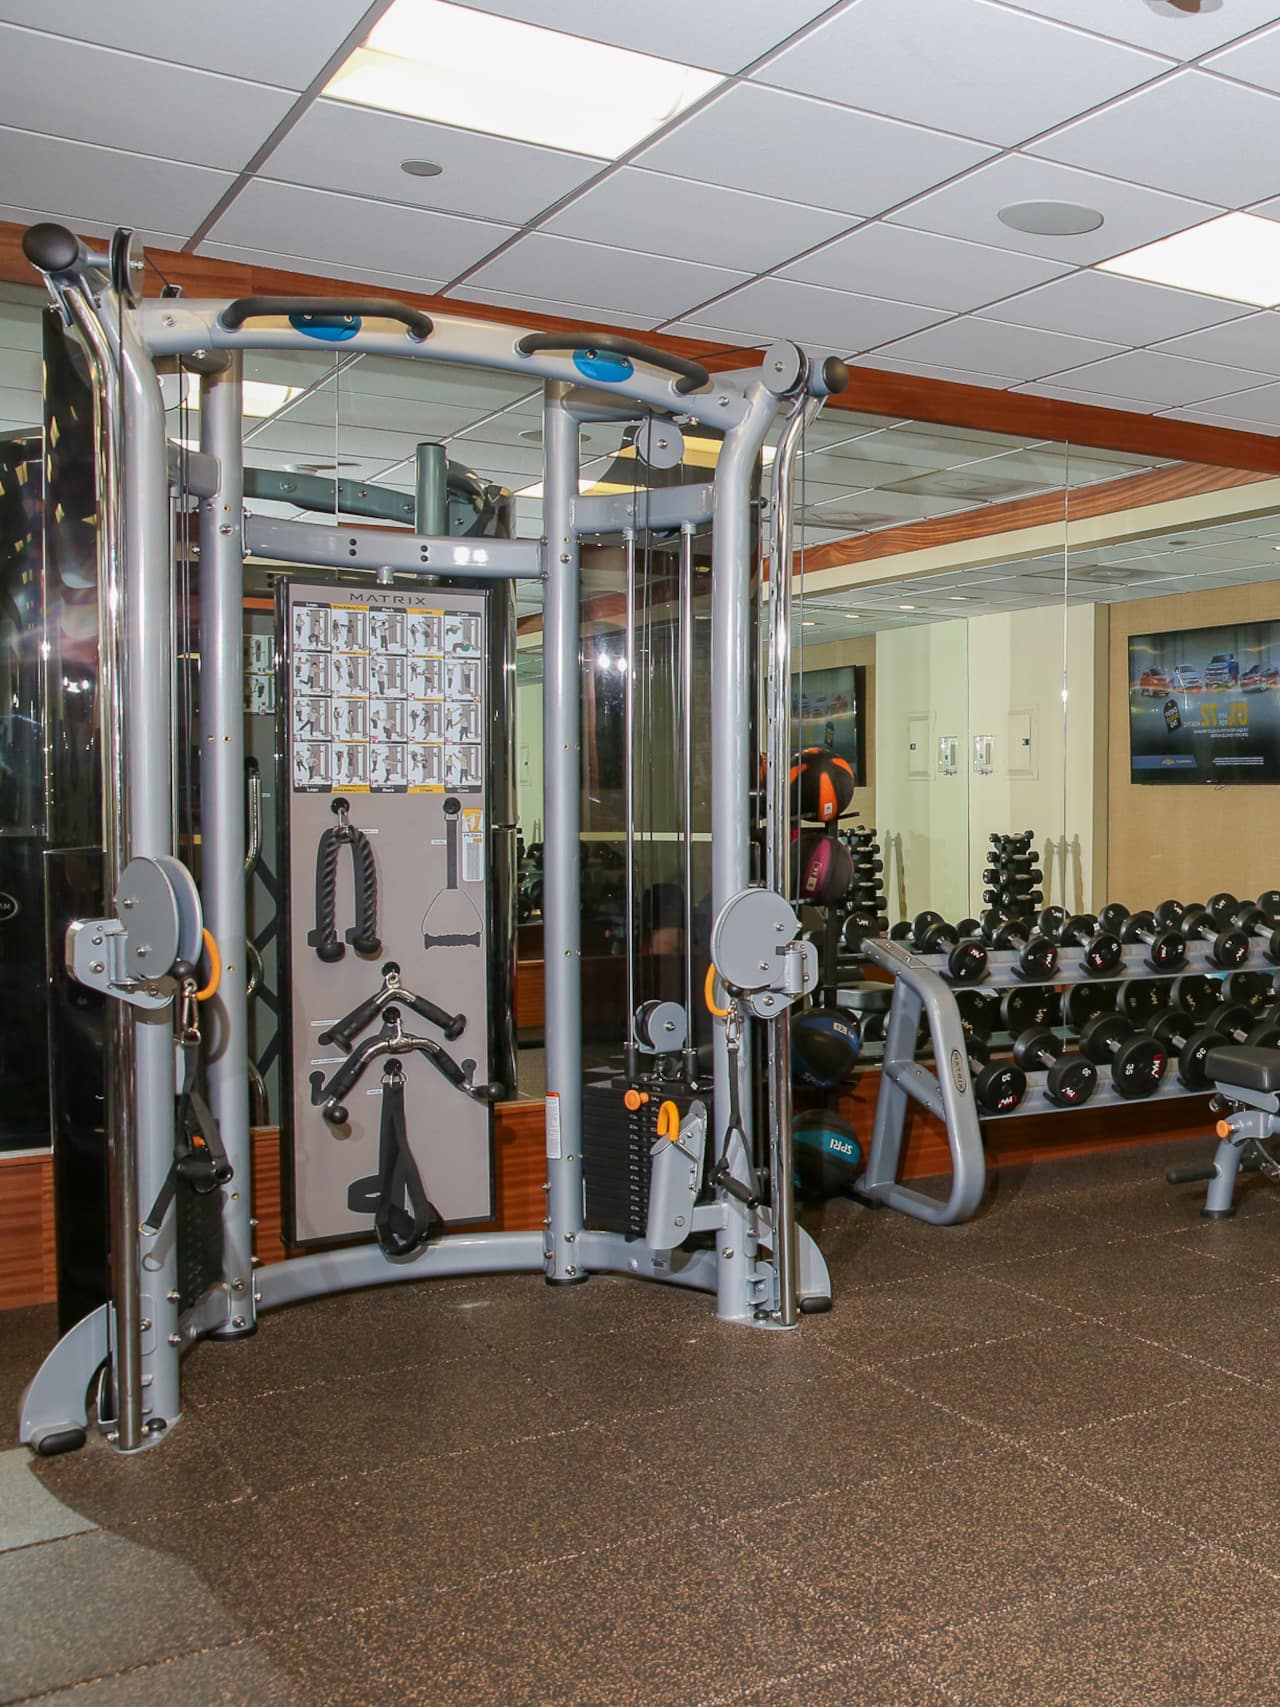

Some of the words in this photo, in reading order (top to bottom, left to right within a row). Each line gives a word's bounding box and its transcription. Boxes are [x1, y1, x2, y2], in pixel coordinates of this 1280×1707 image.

[350, 593, 426, 605] MATRIX
[1125, 1063, 1134, 1076] 35
[1002, 1073, 1012, 1082] 30
[829, 1138, 853, 1155] SPRI
